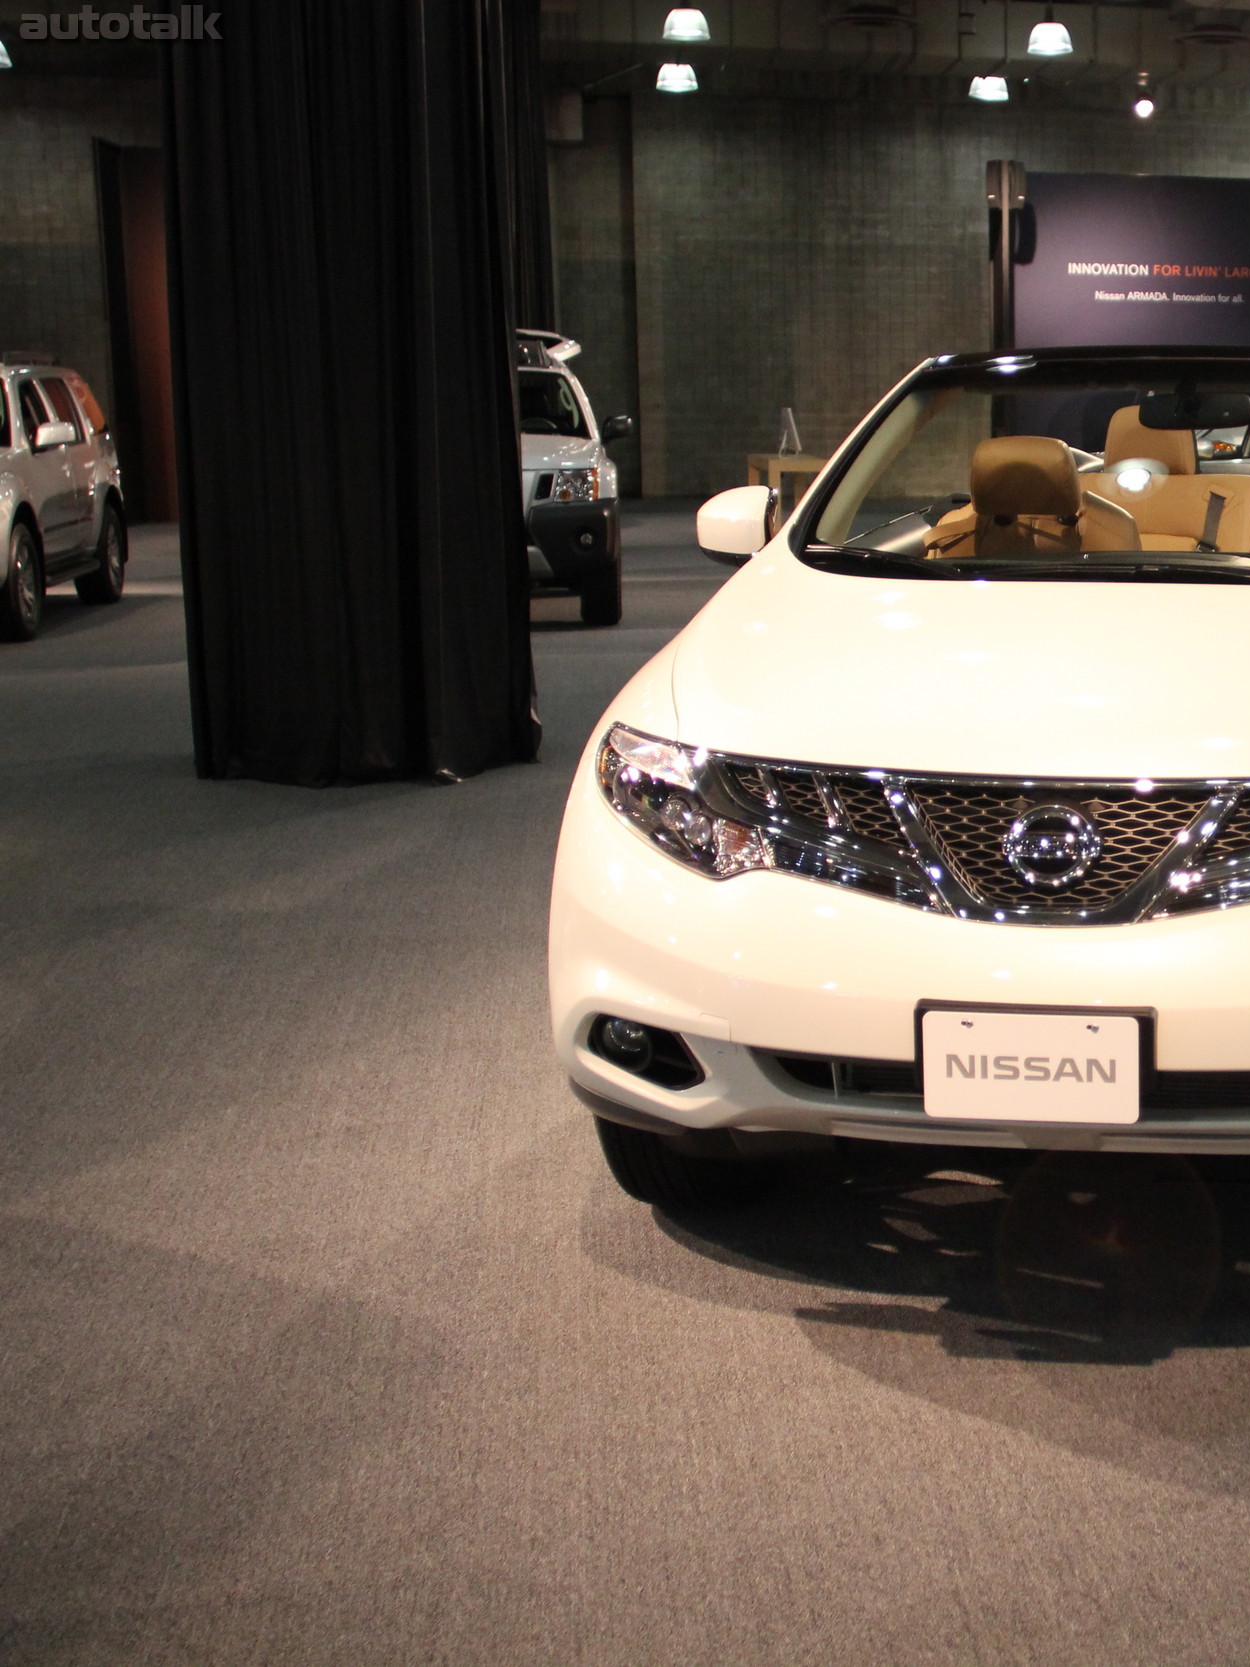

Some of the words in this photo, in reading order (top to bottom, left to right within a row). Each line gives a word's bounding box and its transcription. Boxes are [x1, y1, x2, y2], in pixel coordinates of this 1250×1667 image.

[1067, 262, 1149, 276] INNOVATION
[1153, 264, 1181, 276] FOR
[1185, 265, 1221, 278] LIVIN'
[1095, 290, 1125, 301] Nissan
[1127, 291, 1170, 301] ARMADA.
[1172, 292, 1216, 303] Innovation
[1218, 293, 1230, 303] for
[946, 1053, 1116, 1084] NISSAN
